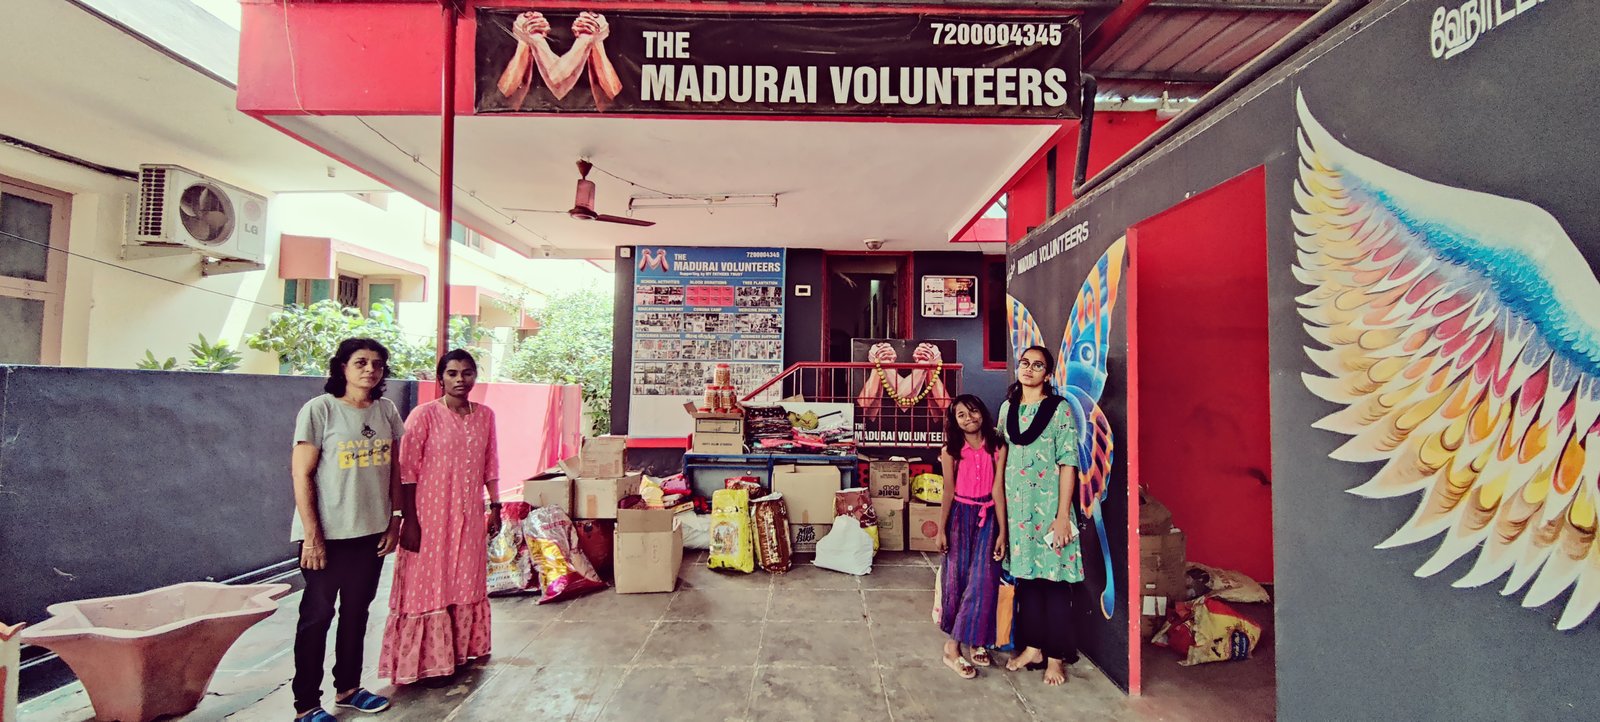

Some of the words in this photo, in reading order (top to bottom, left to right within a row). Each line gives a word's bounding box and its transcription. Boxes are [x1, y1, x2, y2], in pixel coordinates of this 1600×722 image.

[930, 23, 1062, 47] 7200004345
[642, 30, 690, 59] THE
[640, 63, 817, 103] MADURAI
[830, 65, 1068, 107] VOLUNTEERS
[244, 223, 258, 235] LG
[1038, 220, 1089, 264] VOLUNTEERS
[674, 253, 687, 261] THE
[673, 261, 719, 272] MADURAI
[720, 261, 781, 273] VOLUNTEERS
[854, 430, 896, 441] MADURAI
[337, 440, 369, 450] SAVE
